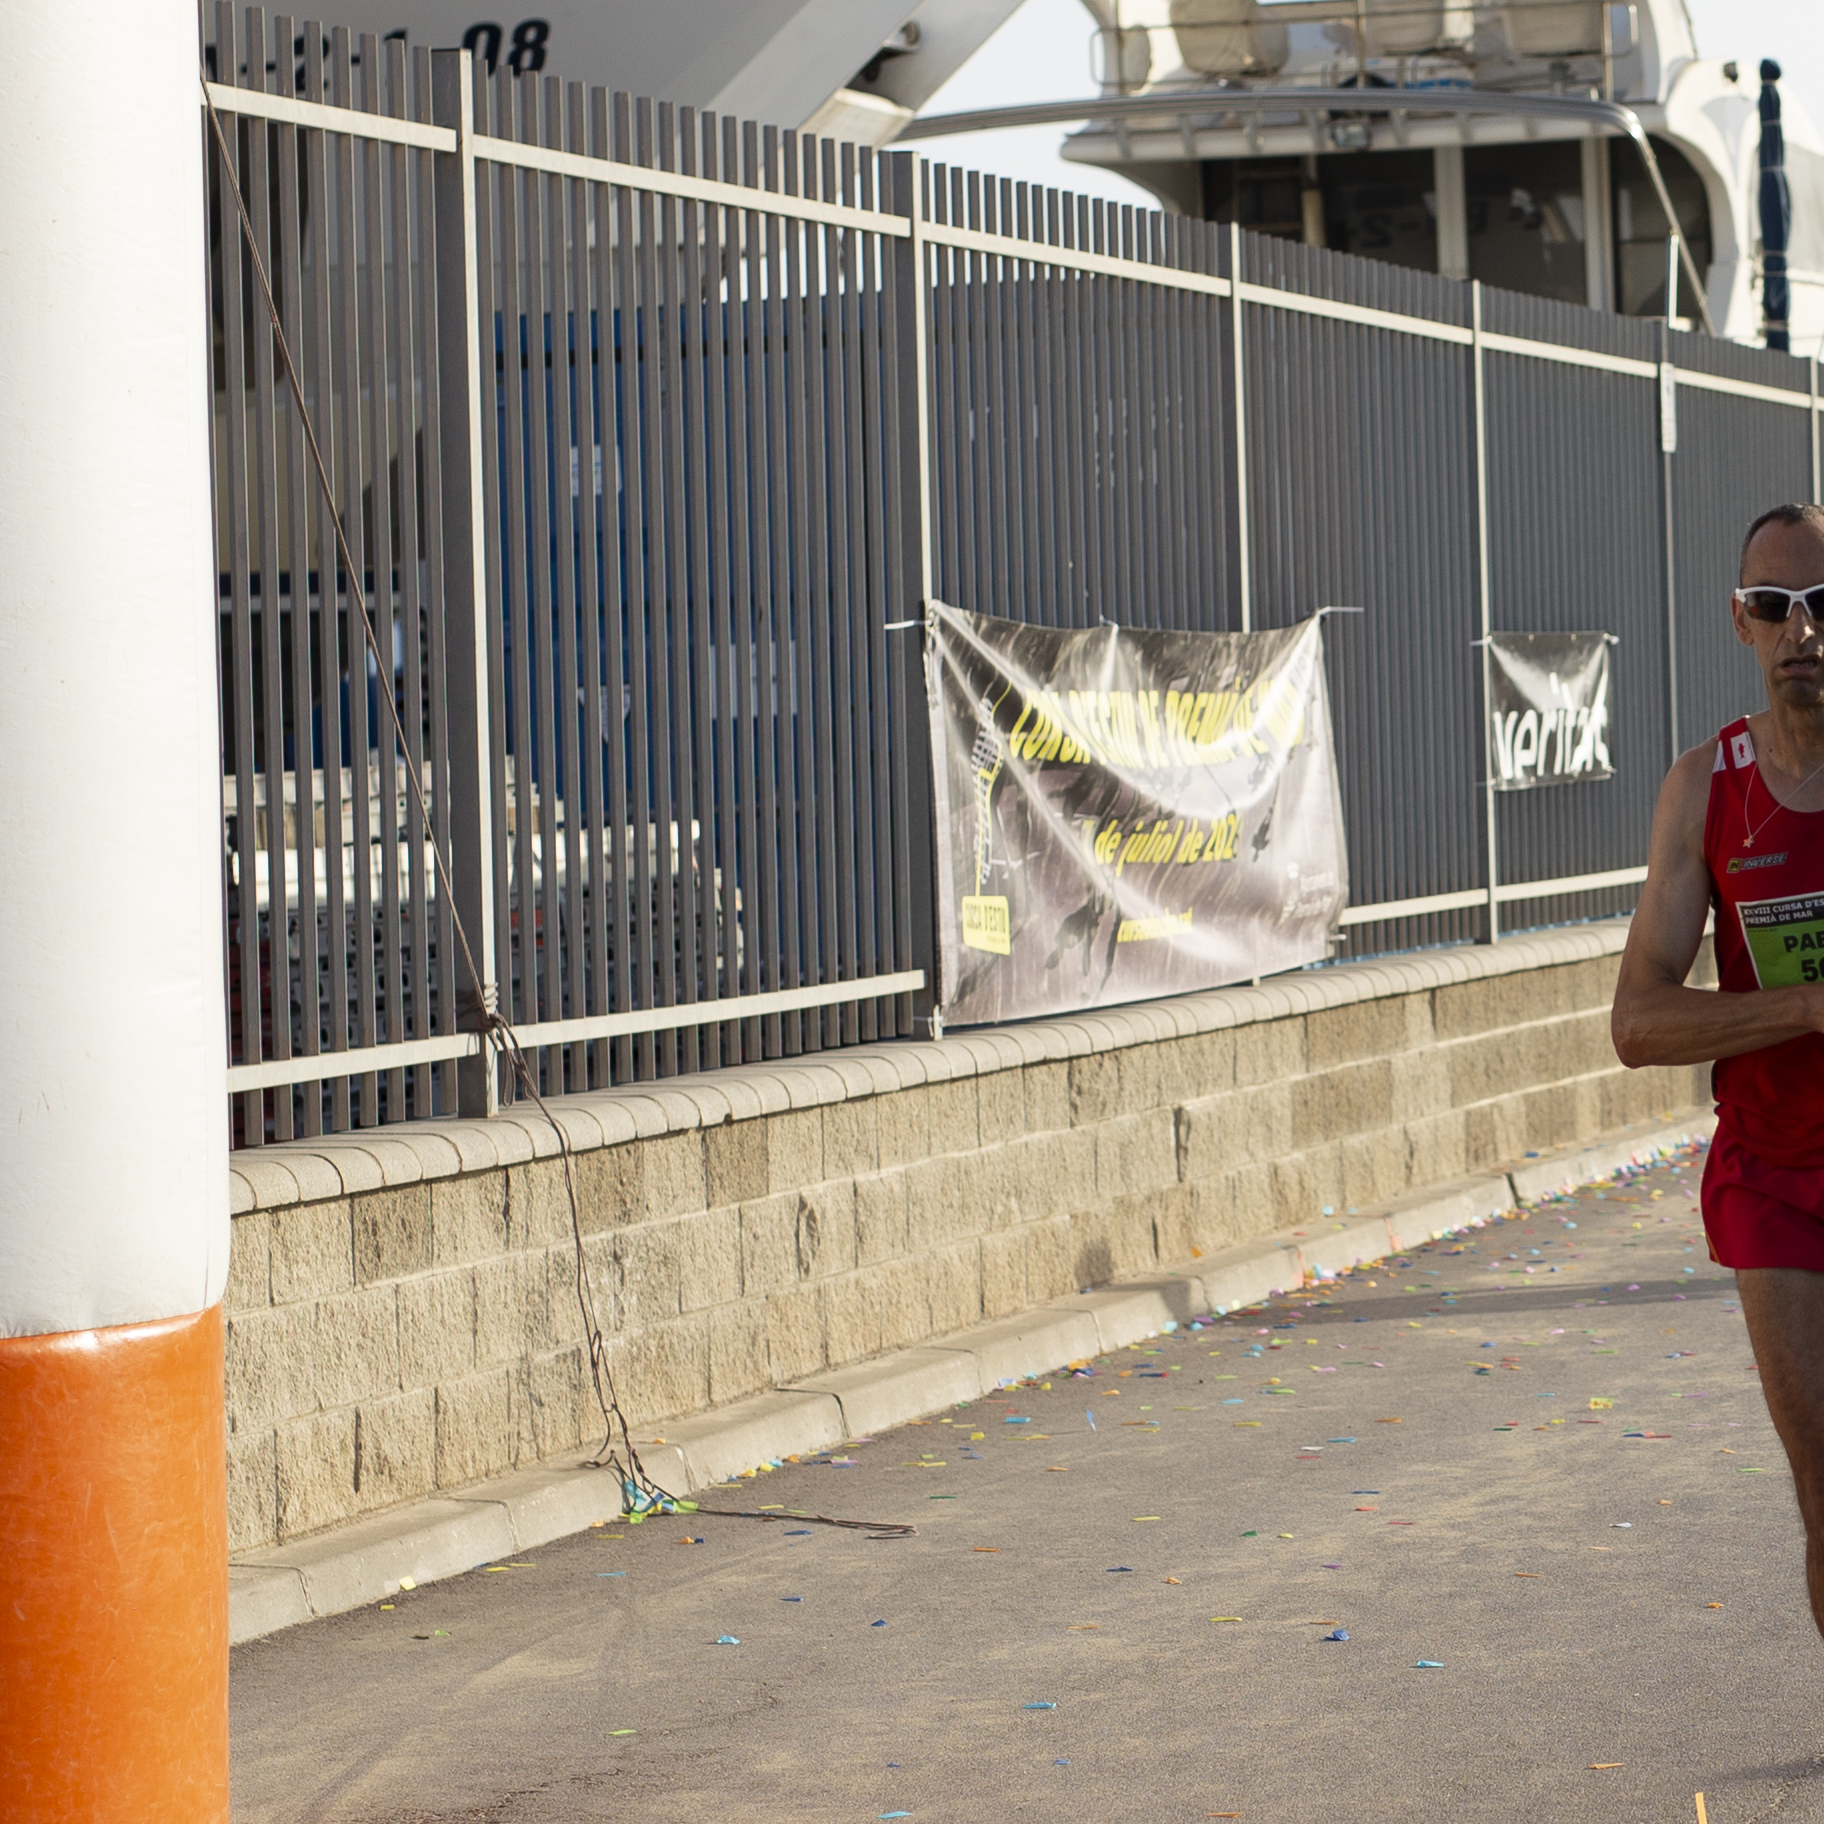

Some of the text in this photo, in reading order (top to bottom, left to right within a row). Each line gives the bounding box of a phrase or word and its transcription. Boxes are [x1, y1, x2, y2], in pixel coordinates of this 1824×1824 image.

[1095, 819, 1122, 865] de
[1115, 820, 1184, 878] juliol
[1177, 818, 1204, 863] de
[1203, 812, 1243, 862] 202
[1772, 902, 1803, 913] CURSA
[1778, 914, 1792, 922] DE
[1792, 910, 1814, 920] MAR
